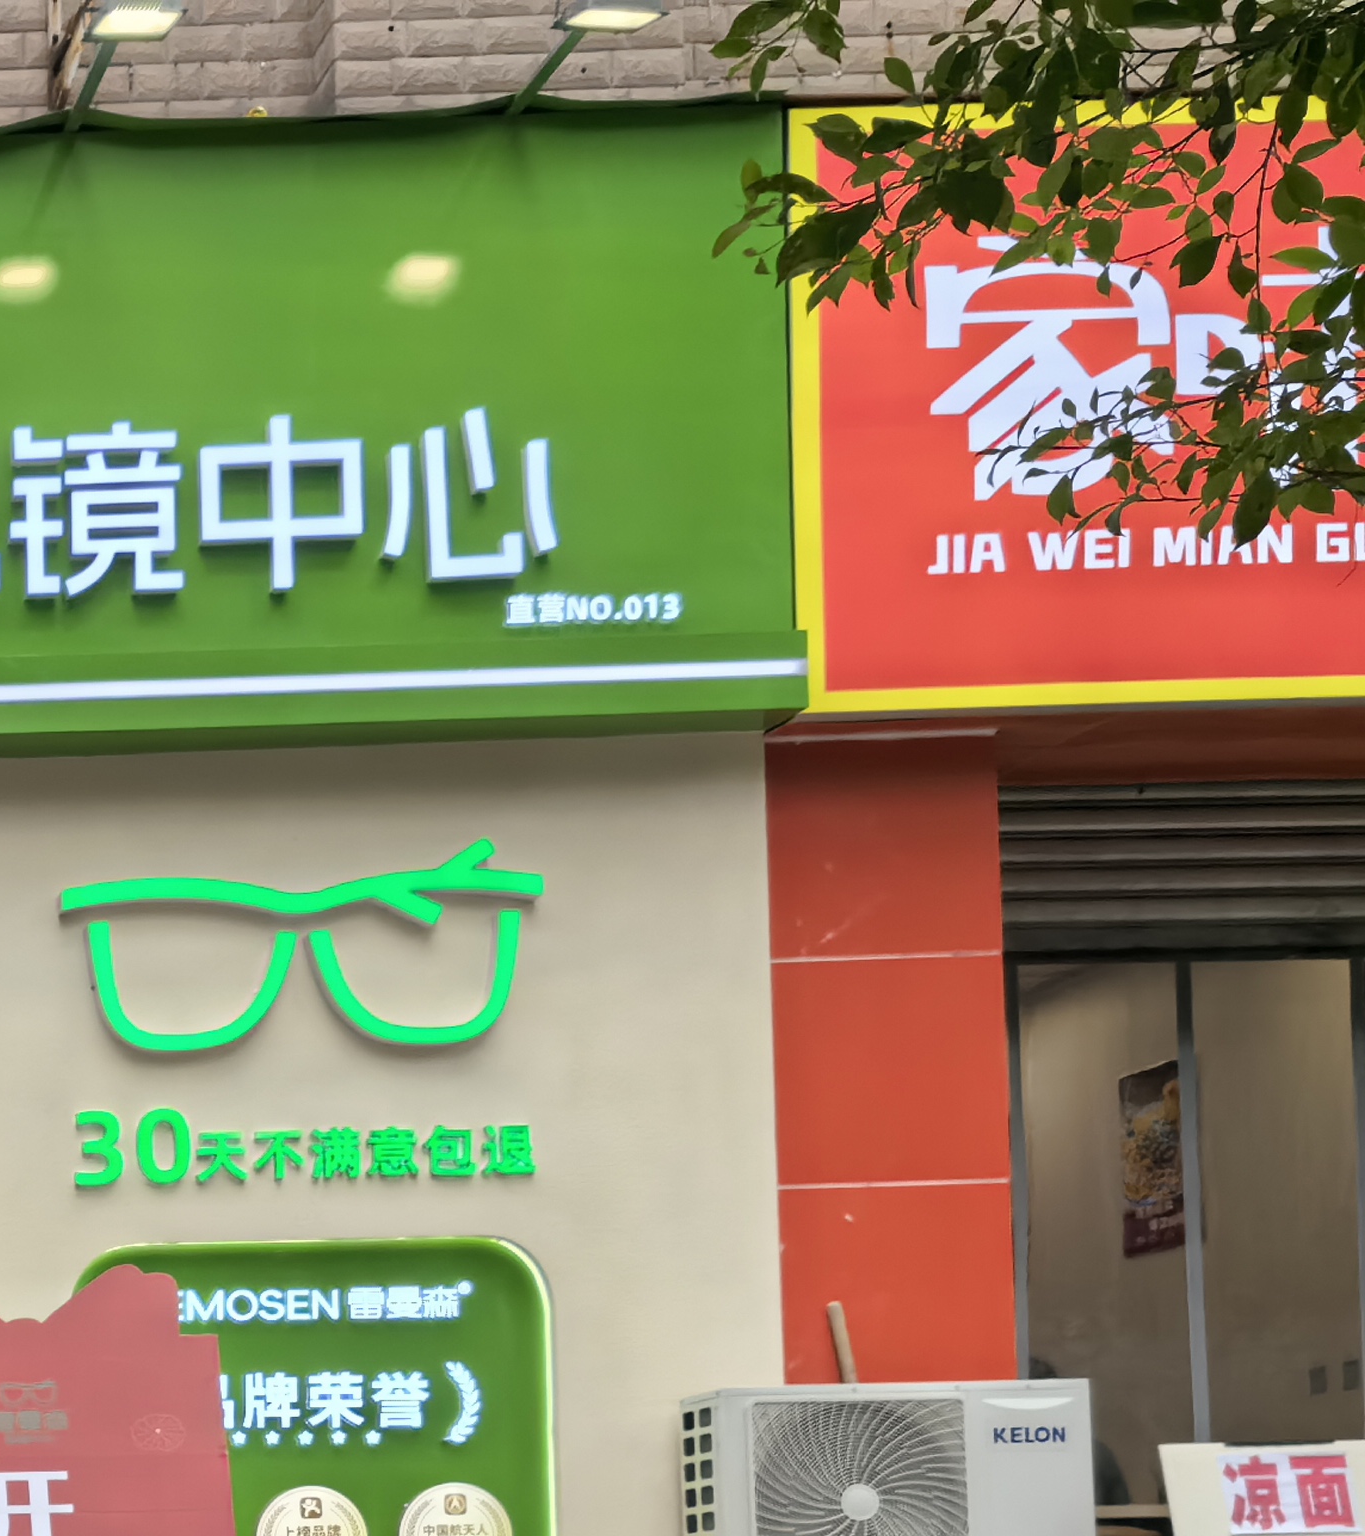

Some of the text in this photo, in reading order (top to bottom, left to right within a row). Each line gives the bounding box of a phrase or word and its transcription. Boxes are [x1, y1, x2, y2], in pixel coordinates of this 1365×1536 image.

[928, 521, 1365, 575] JIA WEI MIAN G
[73, 1107, 537, 1187] 30天不满意包退
[177, 1286, 460, 1322] MOSEN 雷曼森
[992, 1425, 1067, 1444] KELON
[1223, 1455, 1356, 1530] 凉面
